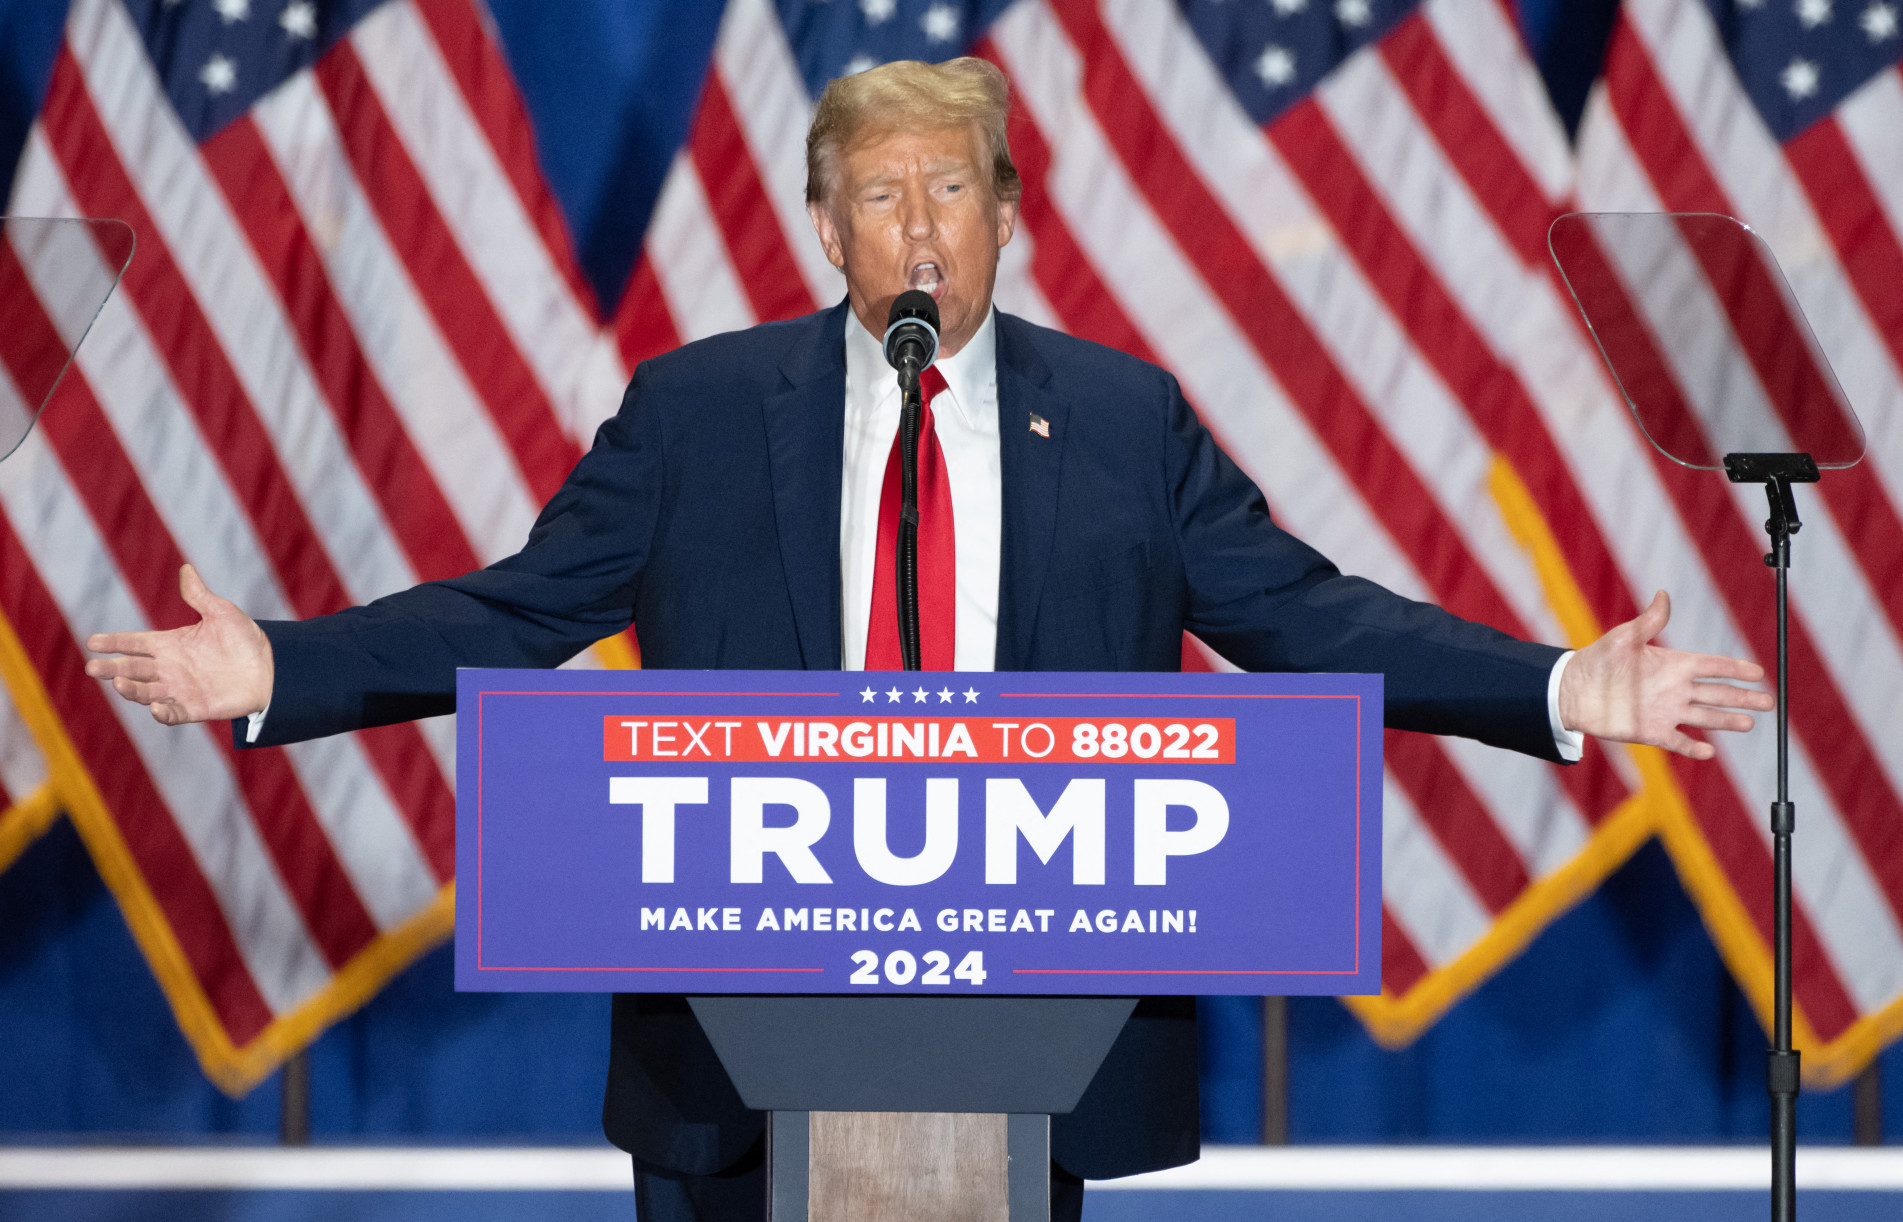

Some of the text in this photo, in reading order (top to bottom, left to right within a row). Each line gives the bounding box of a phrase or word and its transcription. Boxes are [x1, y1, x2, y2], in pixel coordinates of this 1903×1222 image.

[621, 722, 1219, 759] TEXT VIRGINIA TO 88022
[609, 776, 1230, 887] TRUMP
[640, 907, 1197, 934] MAKE AMERICA GREAT AGAIN!
[849, 949, 987, 985] 2024
